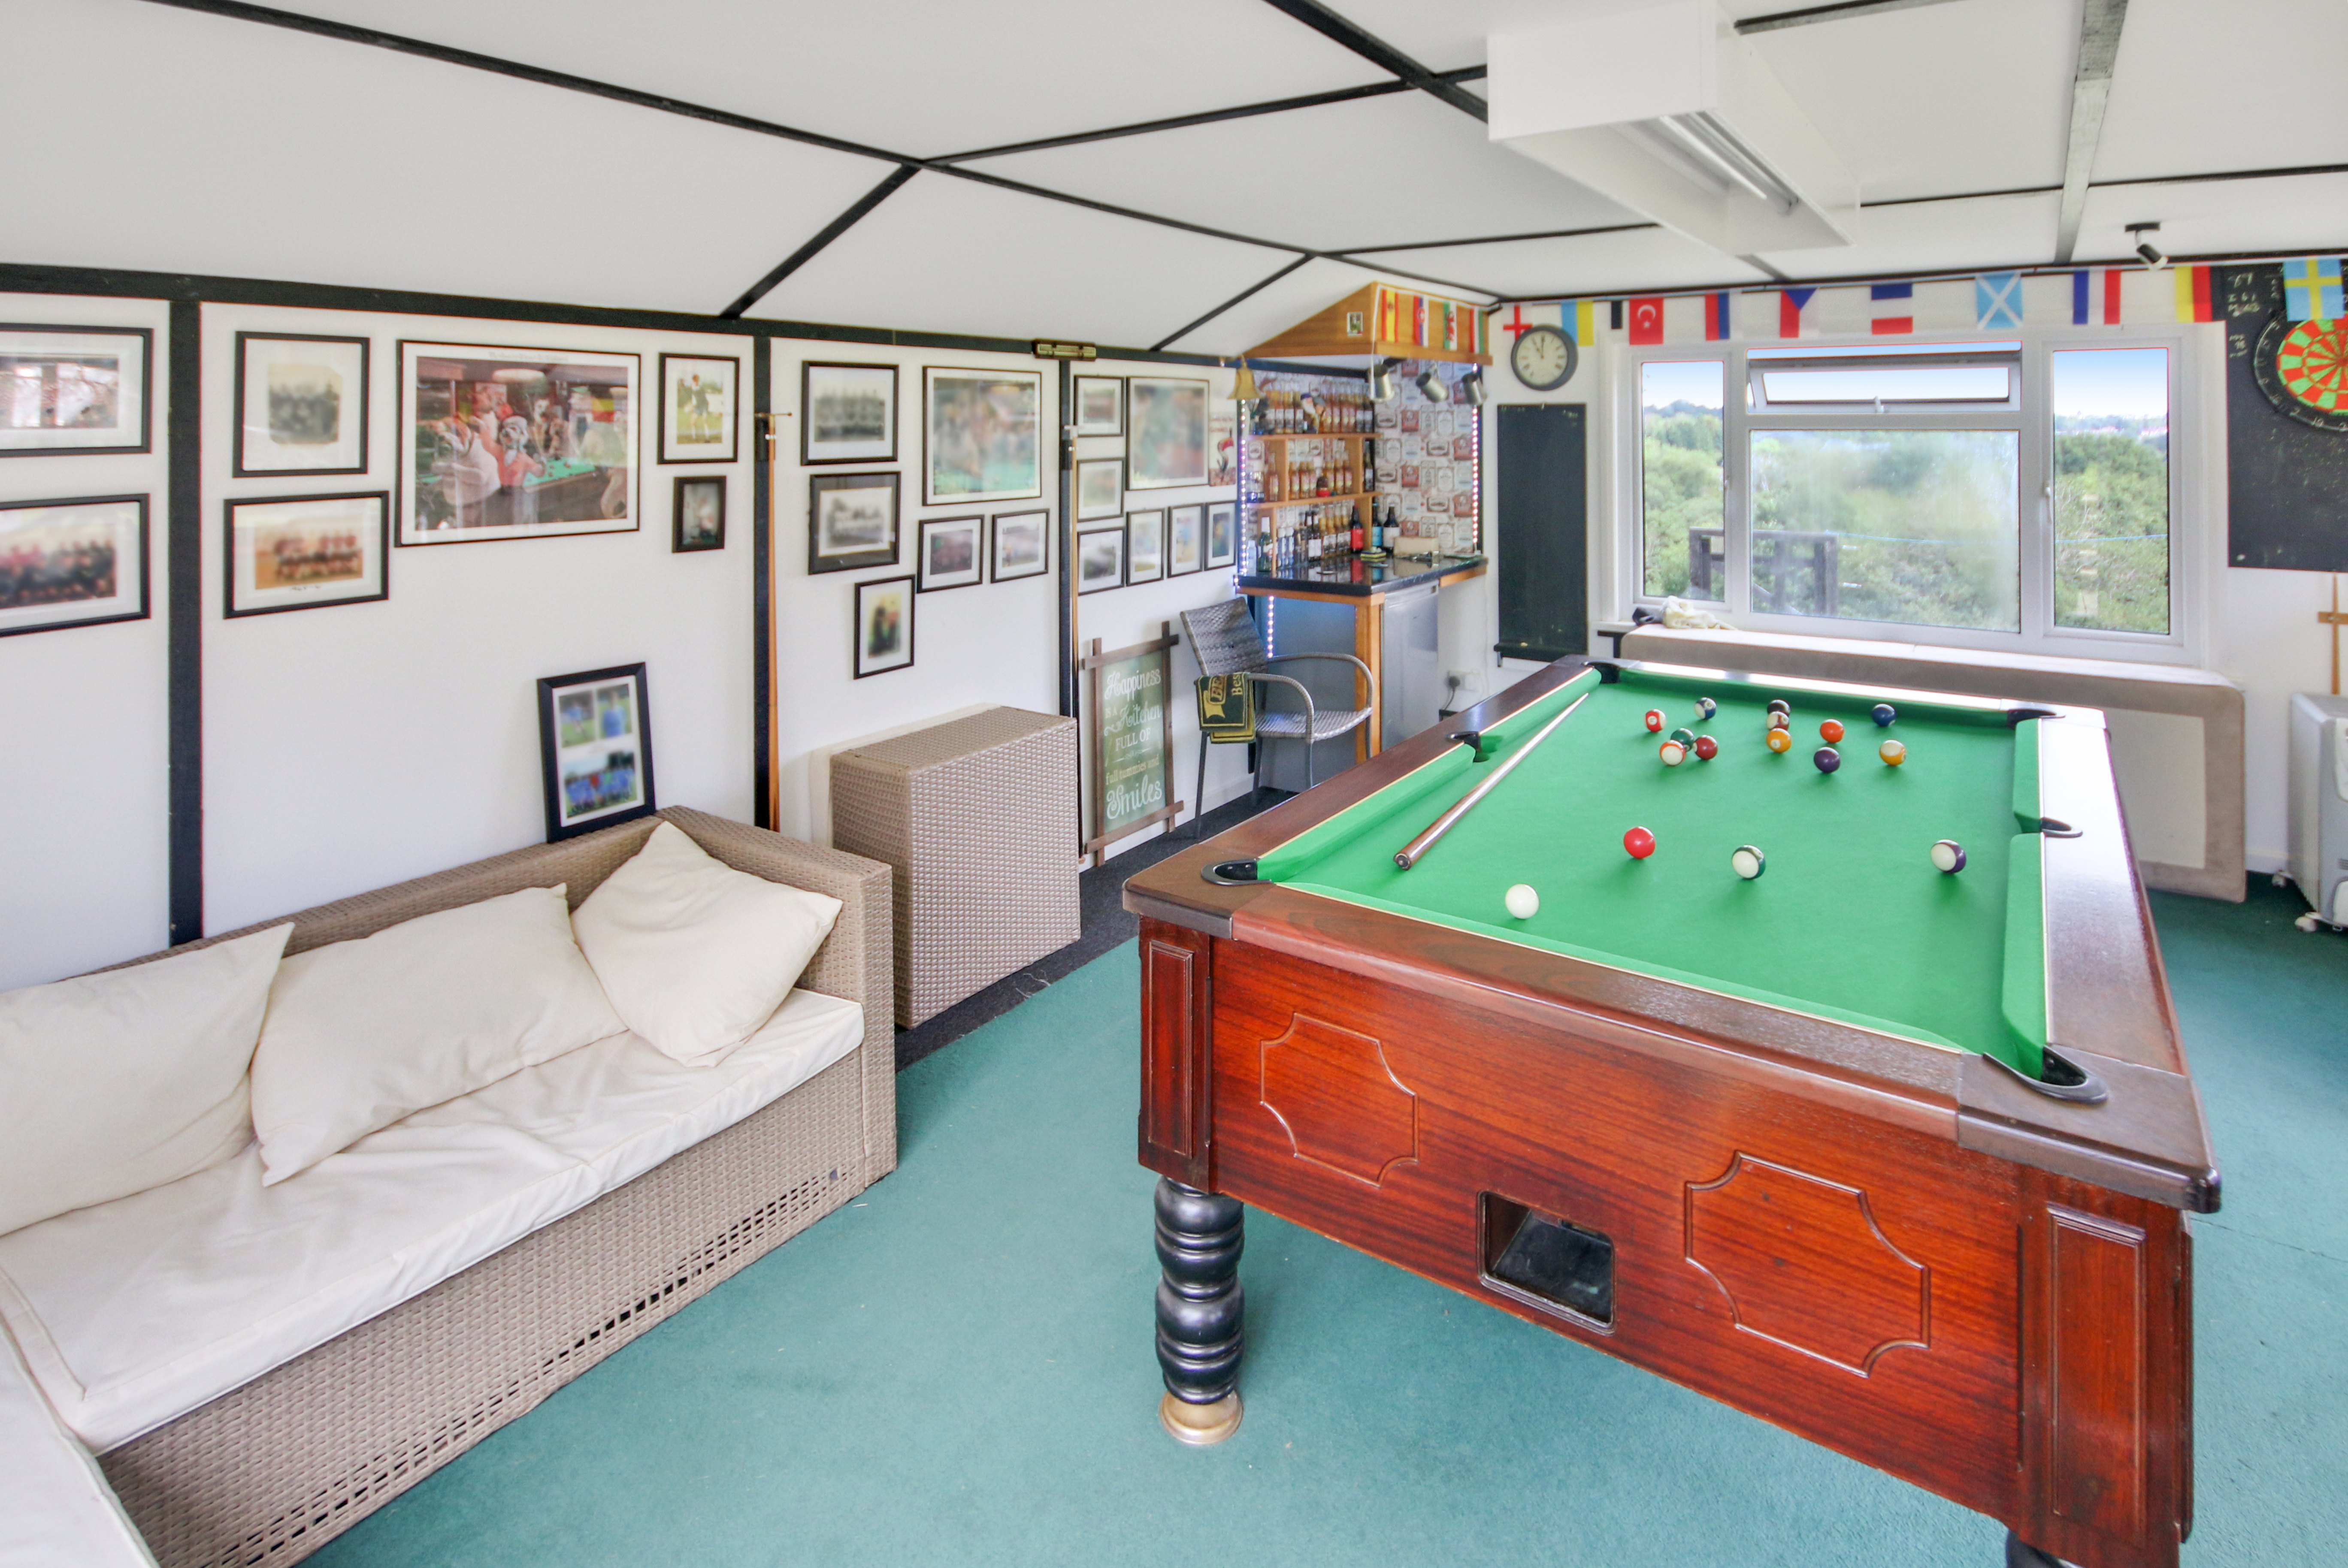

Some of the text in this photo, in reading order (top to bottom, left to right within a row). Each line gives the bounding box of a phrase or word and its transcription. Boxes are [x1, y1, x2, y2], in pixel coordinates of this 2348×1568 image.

[1104, 669, 1161, 702] Happiness
[1231, 674, 1243, 696] Bes
[1105, 701, 1162, 733] IS A Kitchen
[1116, 728, 1151, 751] FULL OF
[1106, 754, 1160, 785] full tummies and
[1106, 774, 1162, 819] Smiles
